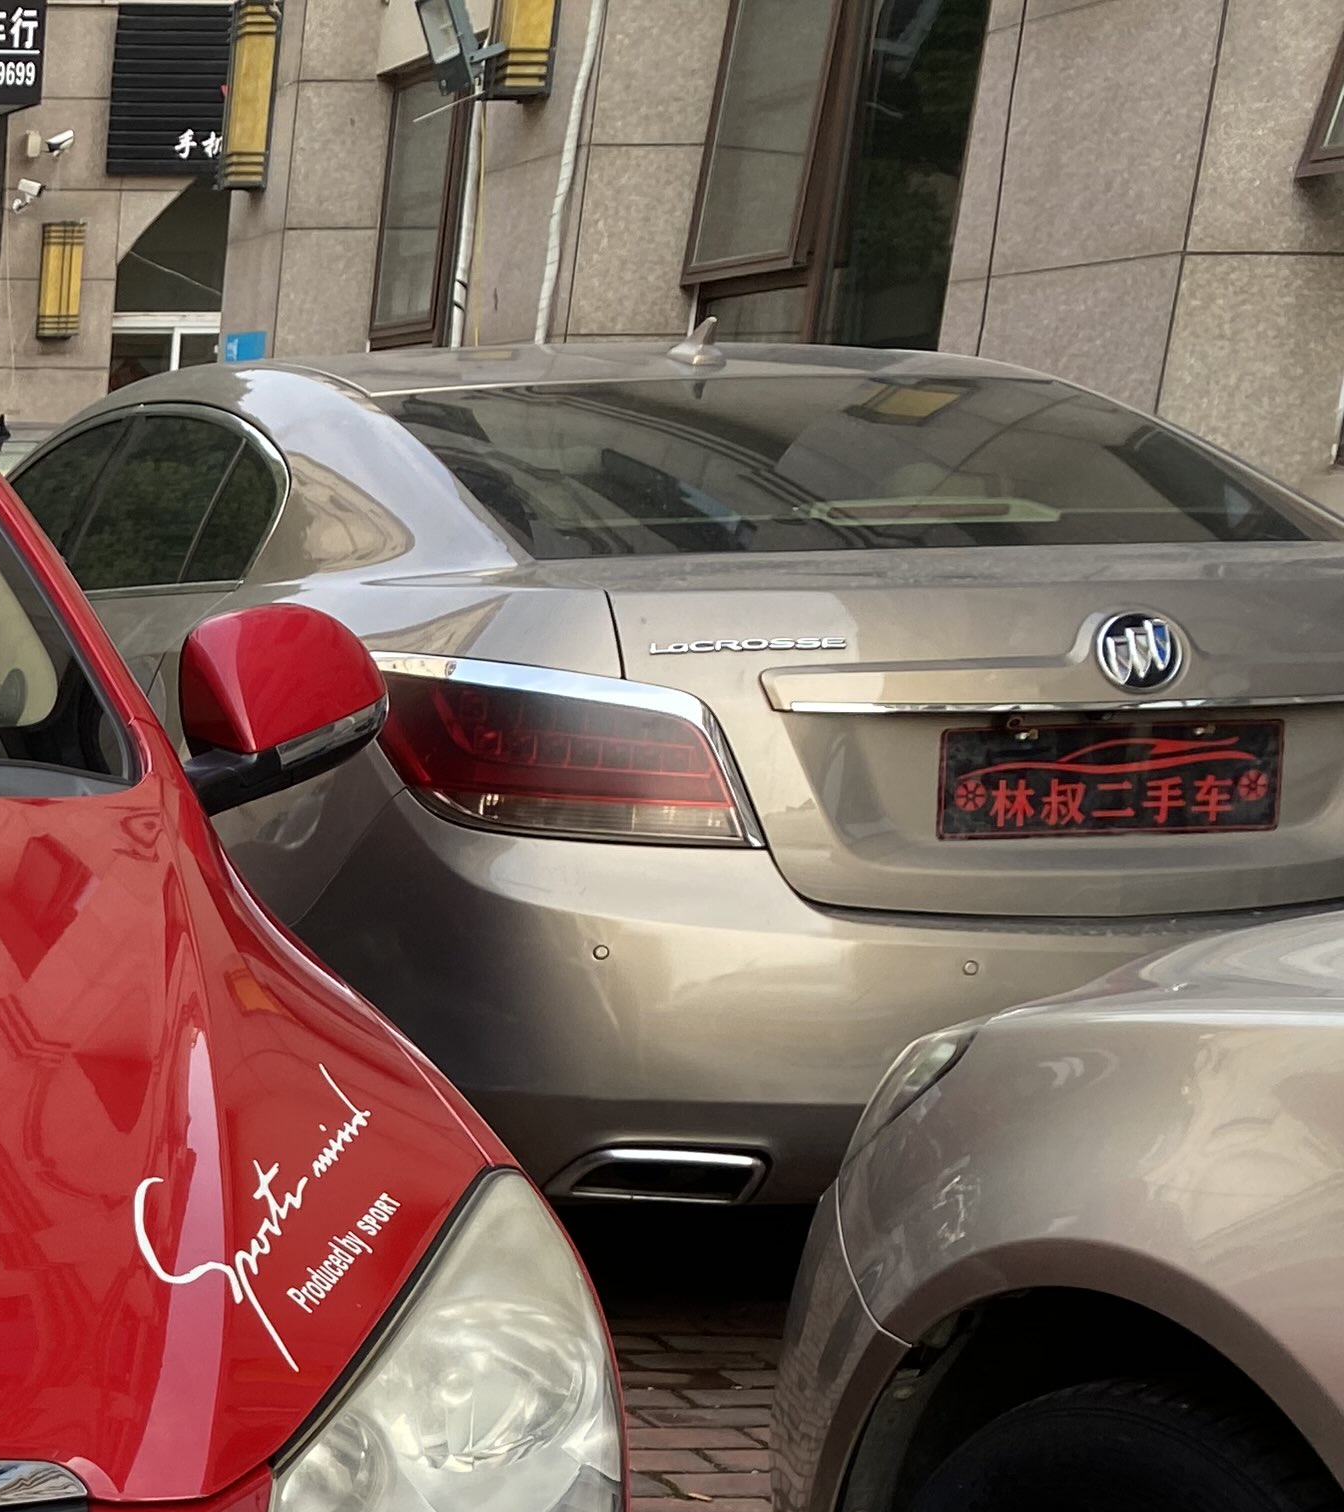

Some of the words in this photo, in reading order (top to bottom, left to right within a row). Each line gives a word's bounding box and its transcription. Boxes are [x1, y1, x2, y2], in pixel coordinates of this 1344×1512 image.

[989, 774, 1234, 828] 林叔二手车
[286, 1241, 355, 1313] Produced
[333, 1231, 373, 1254] by
[356, 1192, 401, 1236] SPORT
